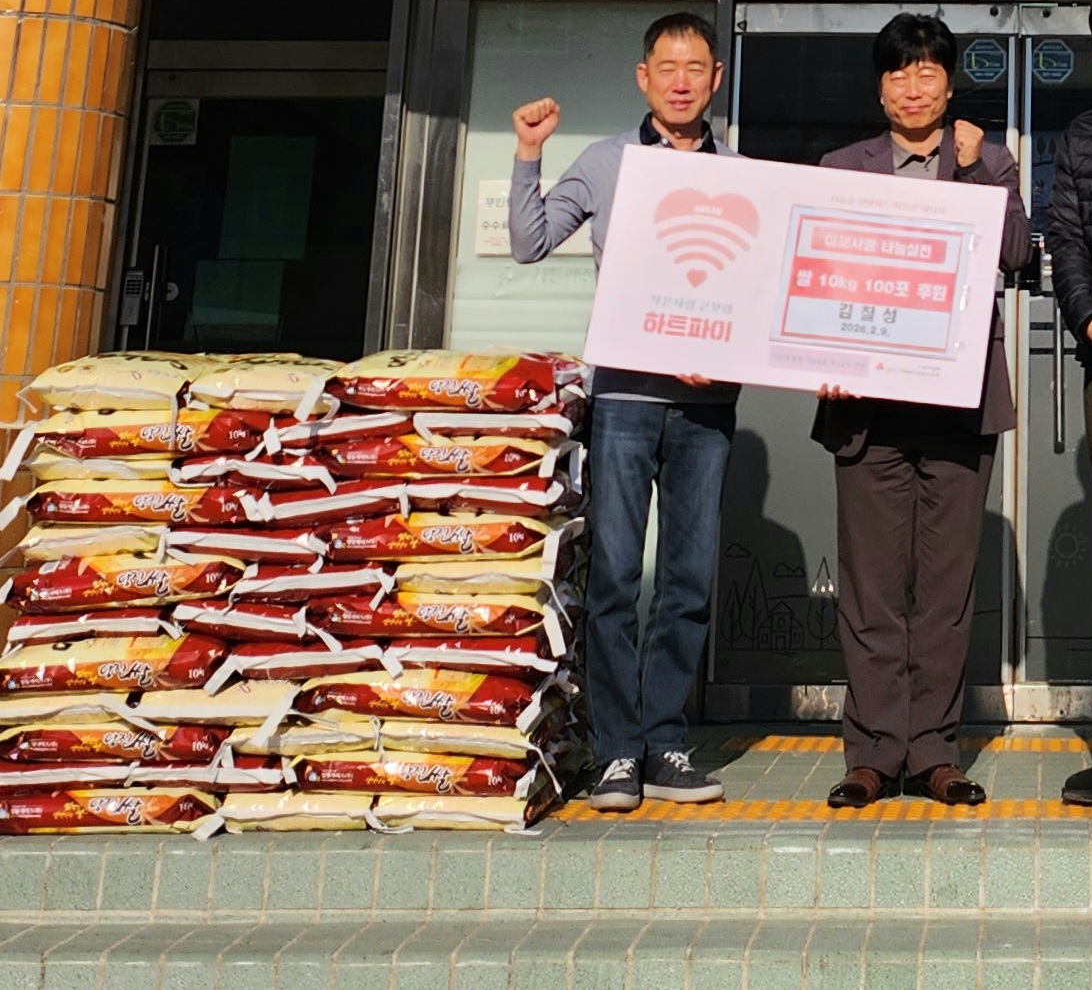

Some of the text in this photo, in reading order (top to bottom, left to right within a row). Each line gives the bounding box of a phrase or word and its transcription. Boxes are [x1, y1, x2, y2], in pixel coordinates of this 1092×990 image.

[796, 269, 947, 302] 쌀 10kg 100포 후원
[643, 311, 733, 342] 하트파이
